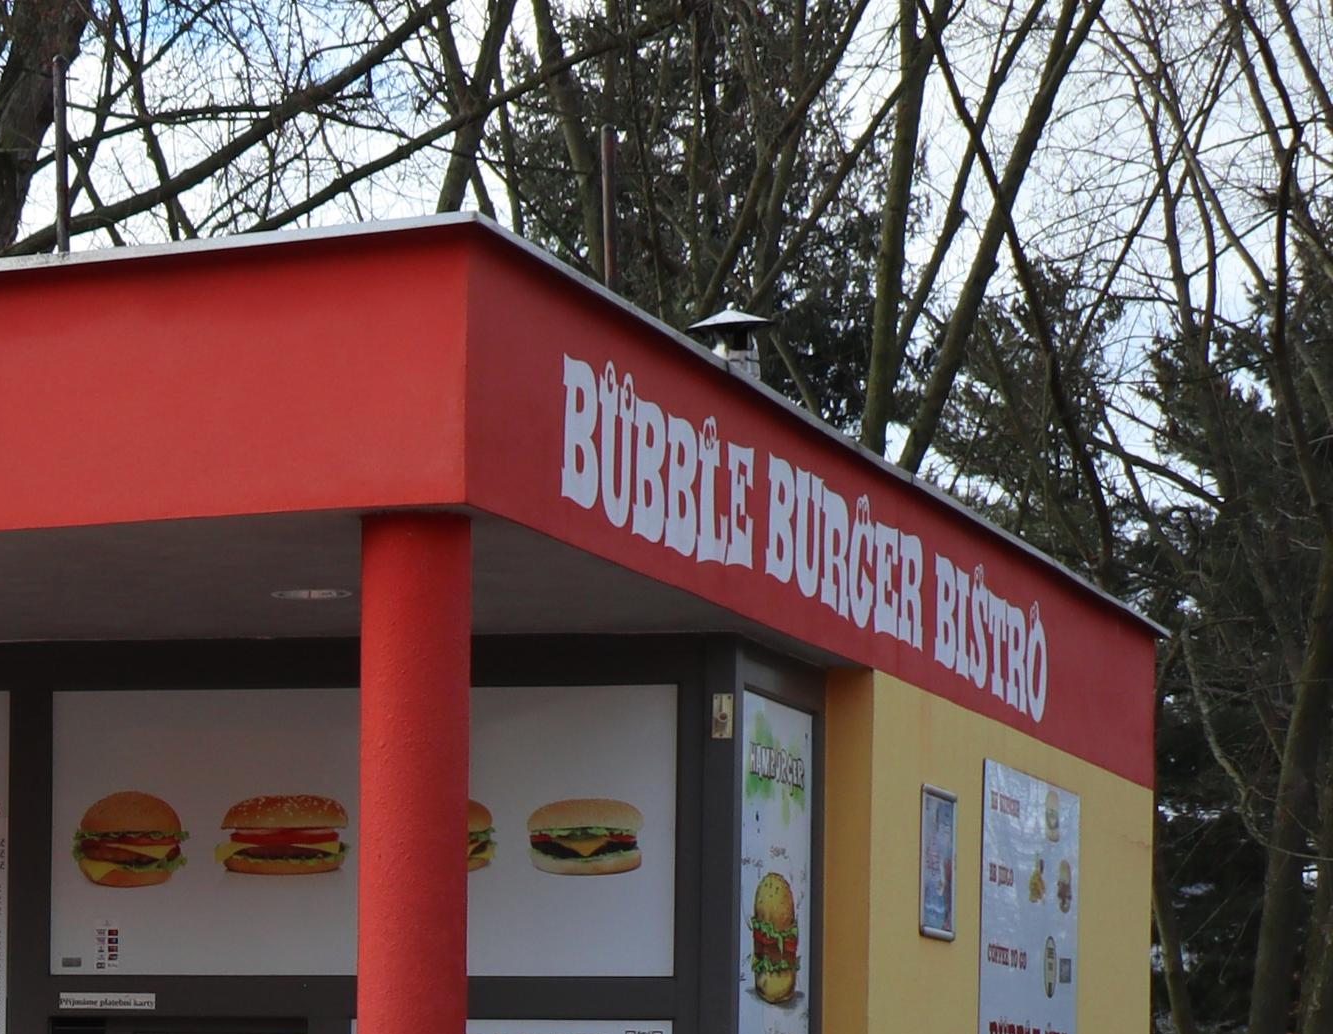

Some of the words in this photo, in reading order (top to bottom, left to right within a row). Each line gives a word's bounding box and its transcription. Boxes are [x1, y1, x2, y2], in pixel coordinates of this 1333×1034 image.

[561, 353, 754, 569] BUBBLE
[765, 452, 924, 652] BURGER
[934, 551, 1048, 723] BISTRO
[750, 741, 805, 792] HAMBURGER
